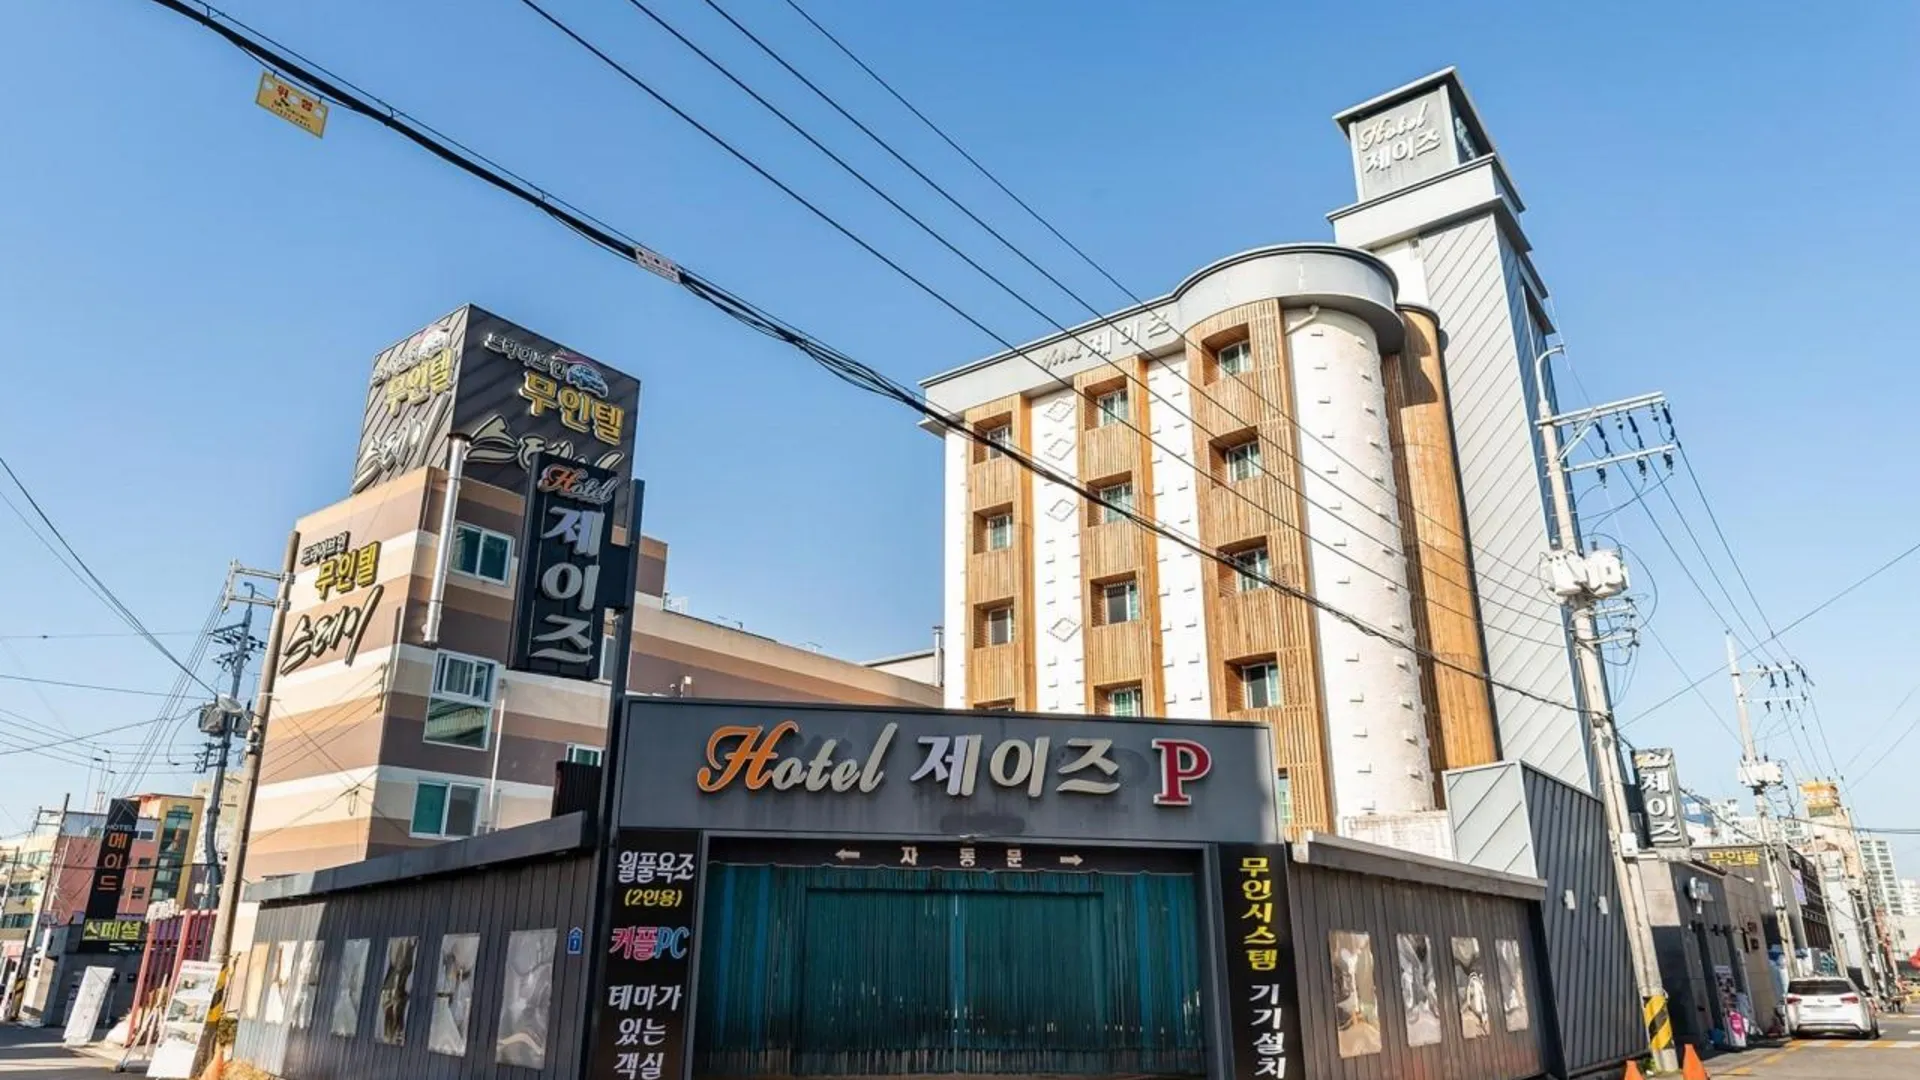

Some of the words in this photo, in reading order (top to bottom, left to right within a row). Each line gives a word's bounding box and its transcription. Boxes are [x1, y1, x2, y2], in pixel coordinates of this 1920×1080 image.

[1361, 101, 1428, 152] Hotel
[1364, 129, 1441, 173] 제이즈
[384, 347, 455, 418] 무인텔
[519, 371, 625, 446] 무인텔
[537, 464, 620, 503] Hotel
[315, 541, 381, 600] 무인텔
[529, 506, 604, 663] 제이즈
[697, 720, 898, 794] Hotel
[910, 734, 1120, 797] 제이즈
[1151, 738, 1212, 806] P
[1639, 770, 1682, 843] 제이즈
[97, 832, 128, 891] 메이드
[617, 850, 695, 884] 월풀욕조
[624, 888, 683, 907] (2인용)
[1239, 857, 1278, 971] 무인시스템
[608, 926, 690, 961] 커플PC
[607, 984, 682, 1011] 테마가
[615, 1018, 666, 1045] 있는
[1249, 984, 1287, 1080] 기기설치
[613, 1052, 664, 1080] 객실
